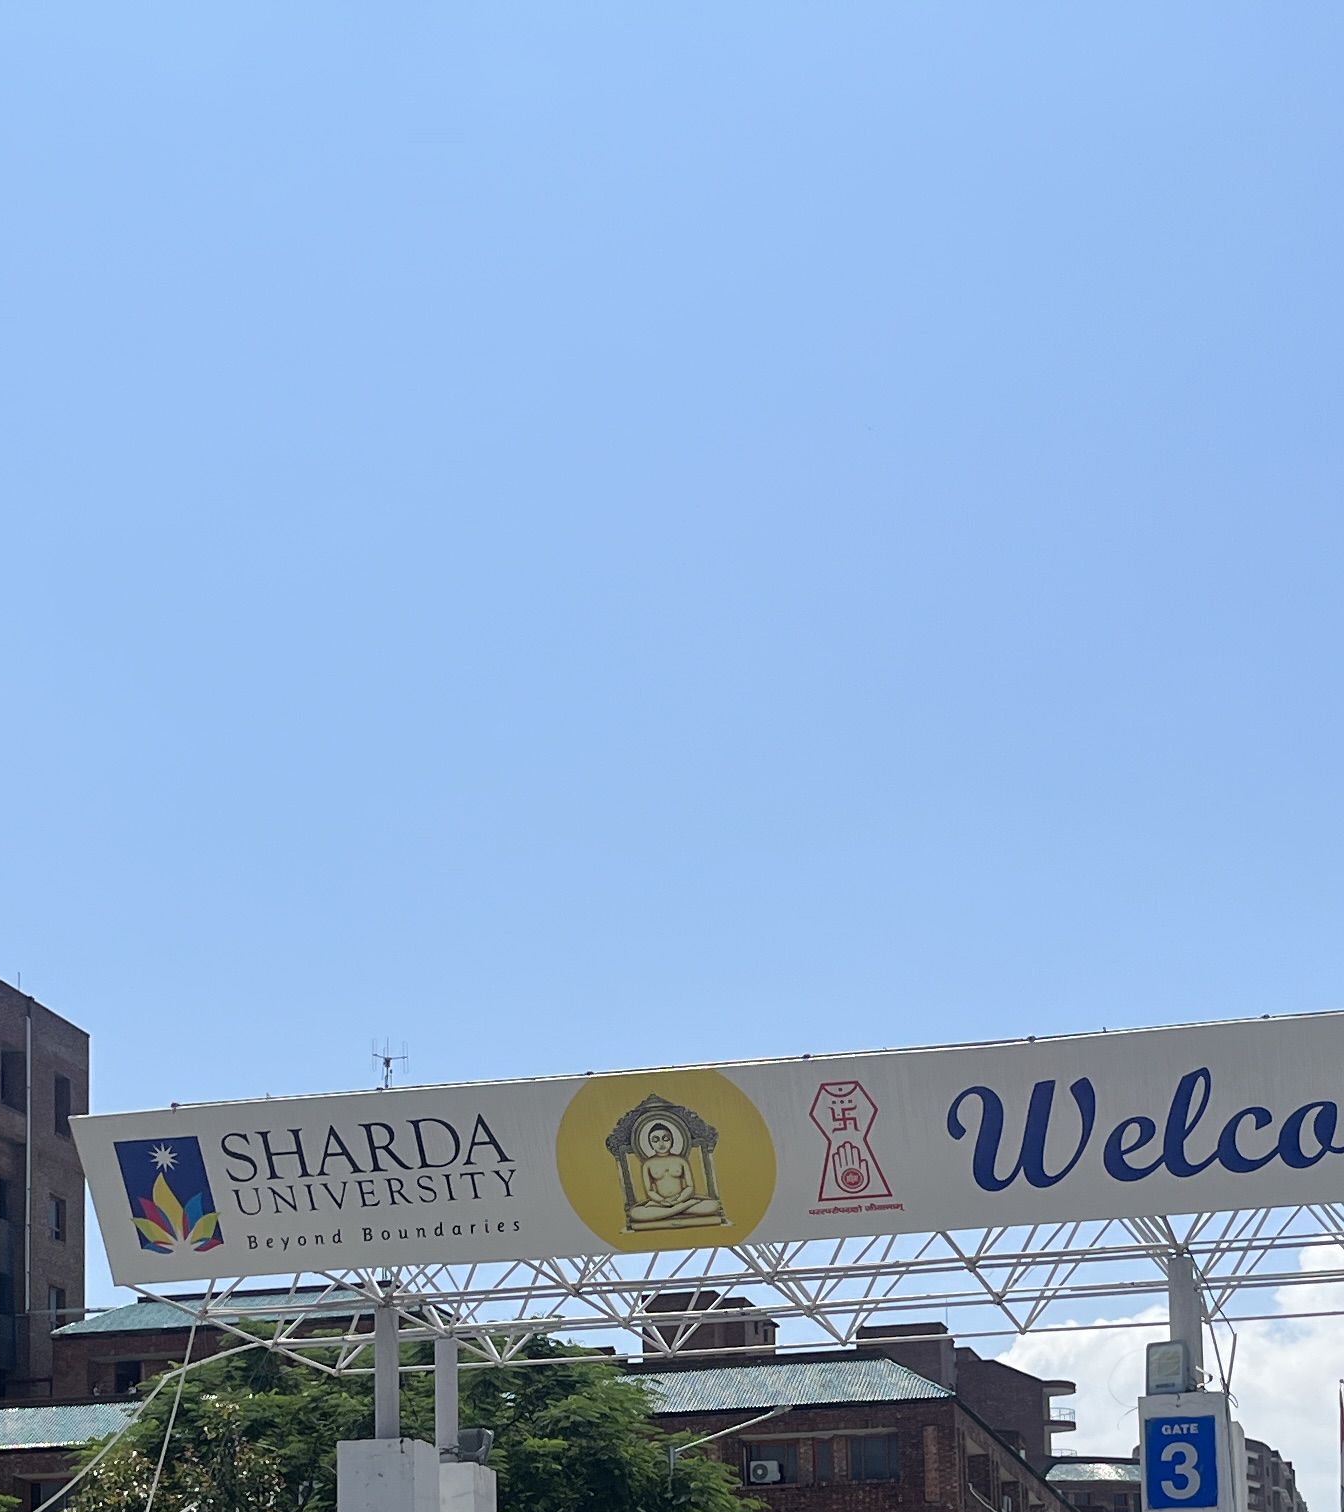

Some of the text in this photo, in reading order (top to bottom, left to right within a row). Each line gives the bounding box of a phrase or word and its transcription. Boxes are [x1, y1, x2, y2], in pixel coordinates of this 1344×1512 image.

[220, 1113, 516, 1183] SHARDA
[231, 1168, 517, 1217] UNIVERSITY
[248, 1218, 522, 1252] Beyond Boundaries
[1161, 1423, 1199, 1435] GATE
[1160, 1441, 1201, 1500] 3
